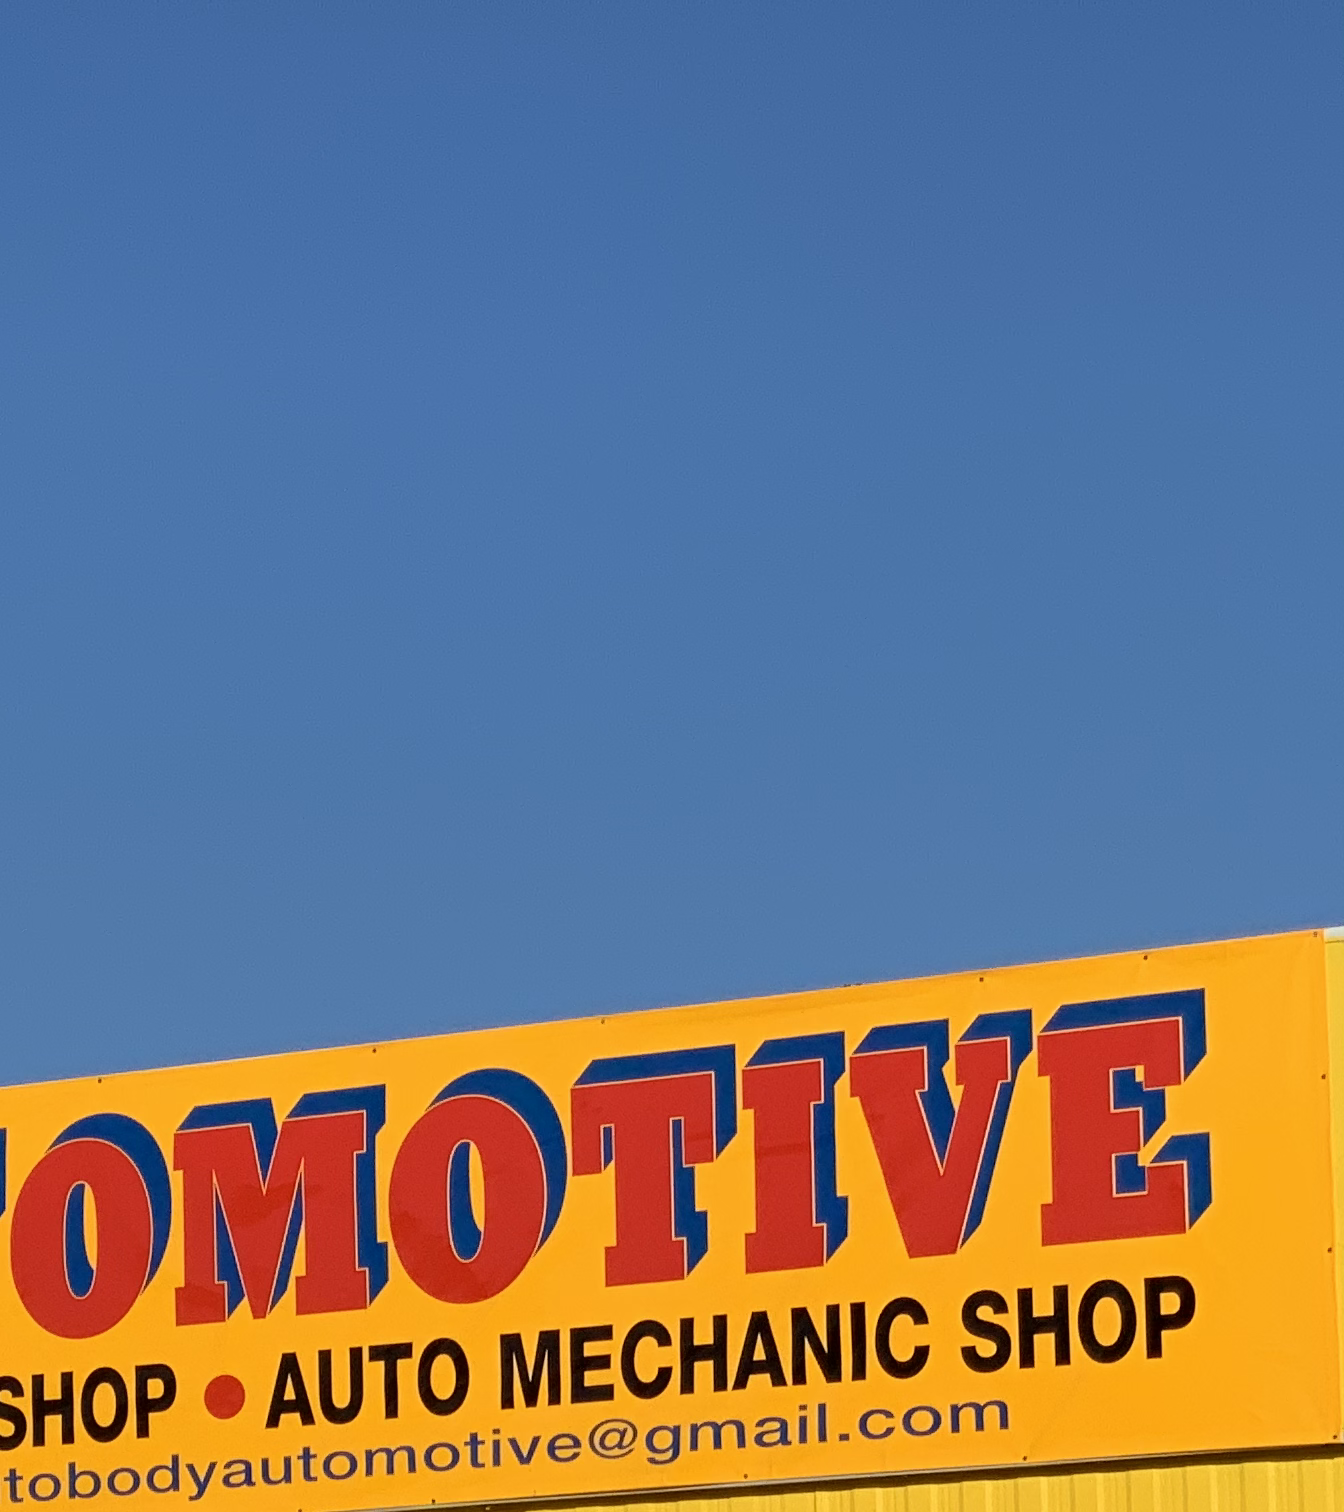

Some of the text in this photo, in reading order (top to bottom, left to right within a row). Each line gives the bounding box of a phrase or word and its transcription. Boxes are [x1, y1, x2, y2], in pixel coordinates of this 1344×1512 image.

[266, 1275, 1197, 1429] AUTO MECHANIC SHOP
